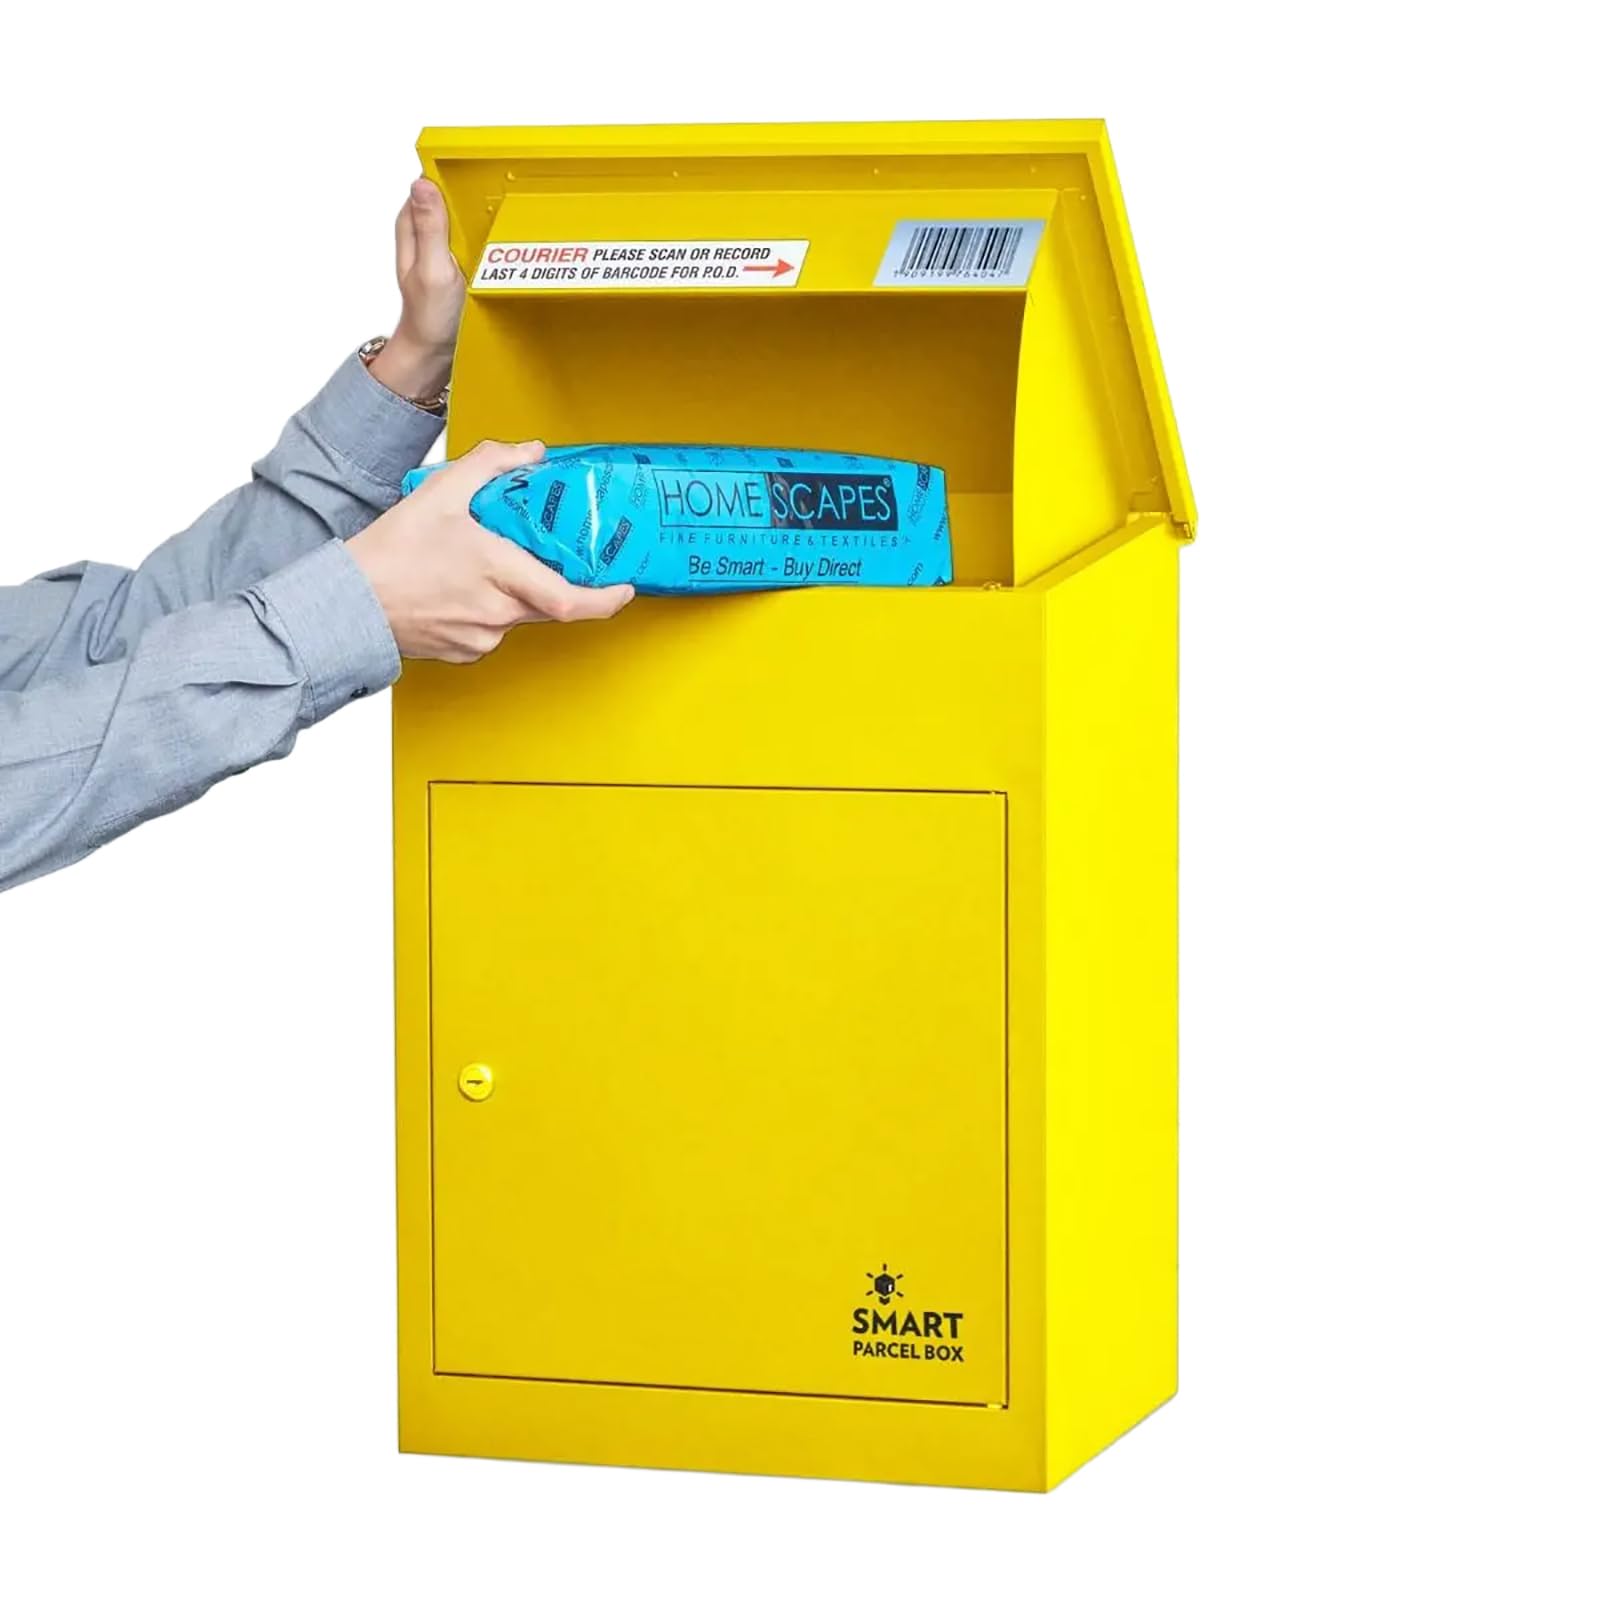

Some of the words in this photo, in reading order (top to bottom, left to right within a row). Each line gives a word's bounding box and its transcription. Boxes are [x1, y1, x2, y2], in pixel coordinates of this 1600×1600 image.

[487, 247, 589, 264] COURIER
[593, 247, 646, 262] PLEASE
[648, 247, 686, 261] SCAN
[690, 247, 711, 261] OR
[713, 246, 771, 261] RECORD
[481, 267, 515, 281] LAST
[519, 267, 528, 281] 4
[531, 266, 578, 281] DIGITS
[581, 266, 600, 280] OF
[603, 266, 669, 280] BARCODE
[671, 265, 700, 279] FOR
[702, 265, 740, 280] P.O.D.
[660, 479, 763, 518] HOME
[660, 531, 697, 545] FINE
[703, 532, 802, 547] FURNITURE
[807, 535, 815, 547] &
[821, 534, 899, 548] TEXTILES
[688, 554, 713, 575] Be
[715, 555, 766, 576] Smart
[783, 556, 816, 582] Buy
[816, 557, 863, 577] Direct
[852, 1308, 964, 1340] SMART
[853, 1340, 921, 1360] PARCEL
[924, 1344, 965, 1363] BOX
